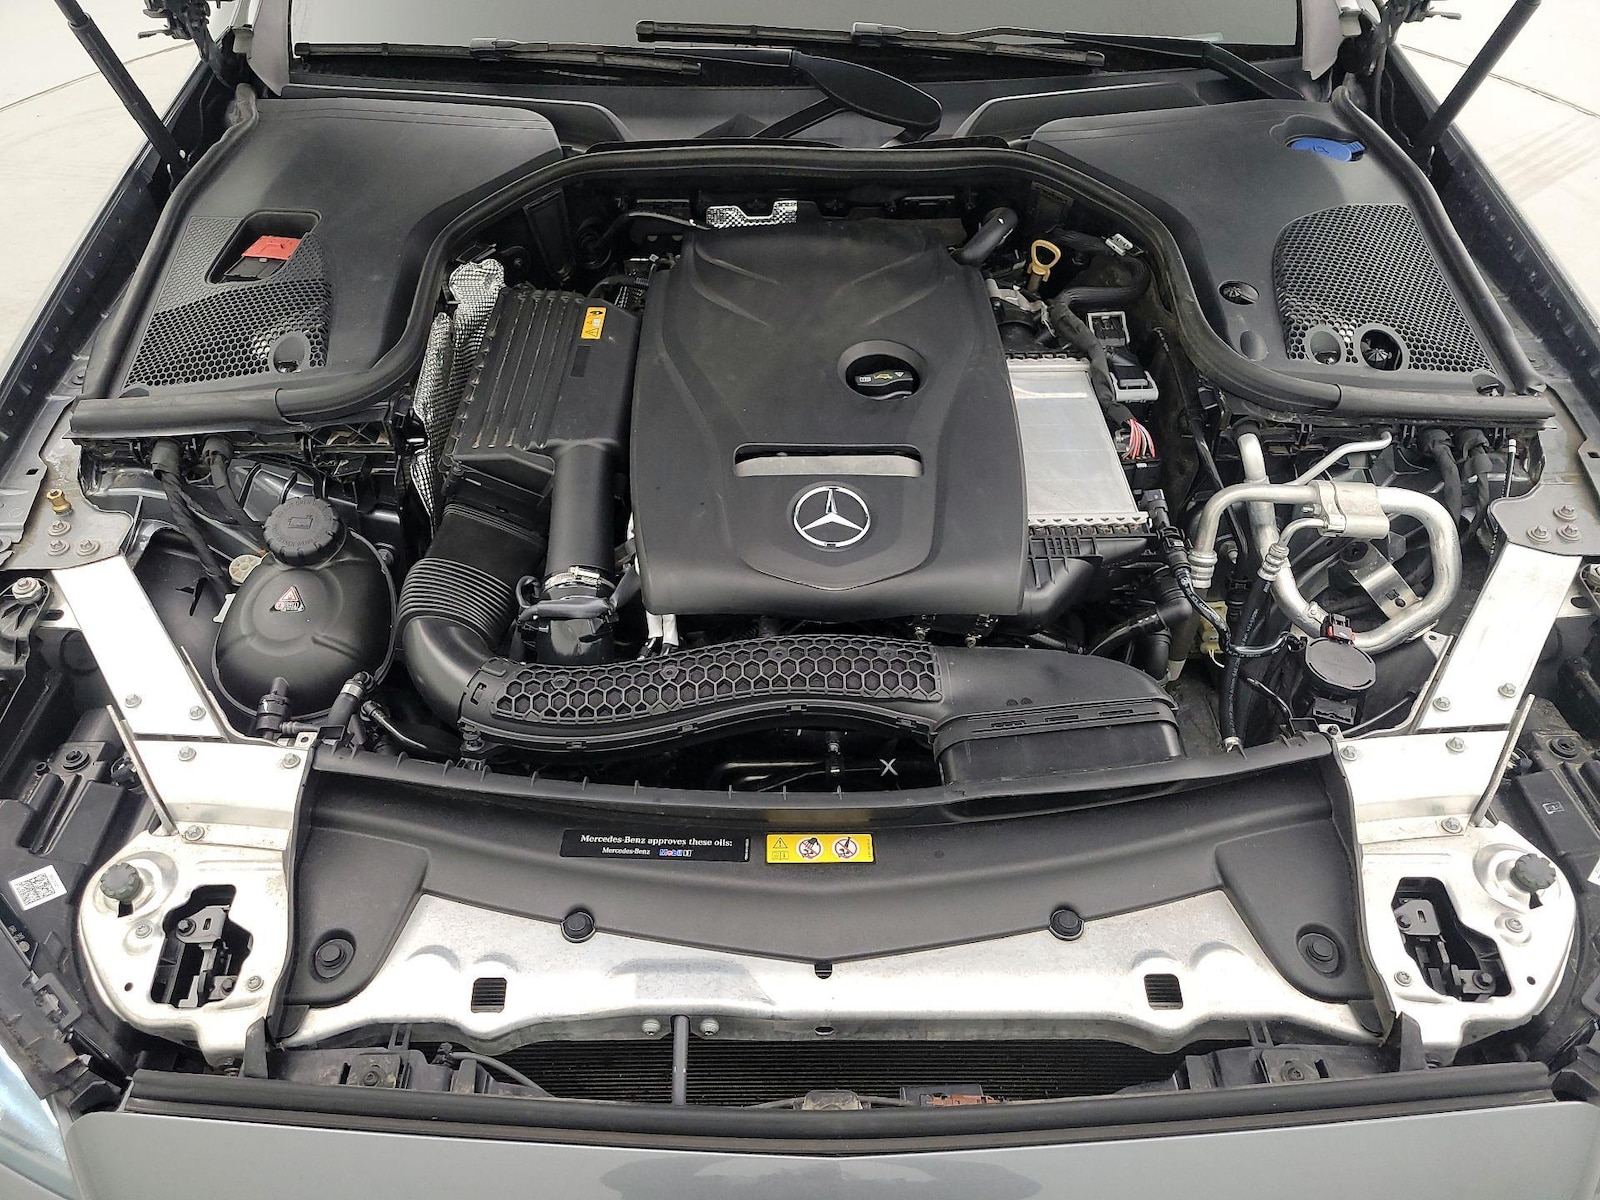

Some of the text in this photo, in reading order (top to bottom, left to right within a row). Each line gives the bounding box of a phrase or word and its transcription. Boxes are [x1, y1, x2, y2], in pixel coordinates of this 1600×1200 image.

[580, 834, 733, 847] Mercedes-Benz approves these oils:
[601, 847, 650, 855] Mercedes-Benz
